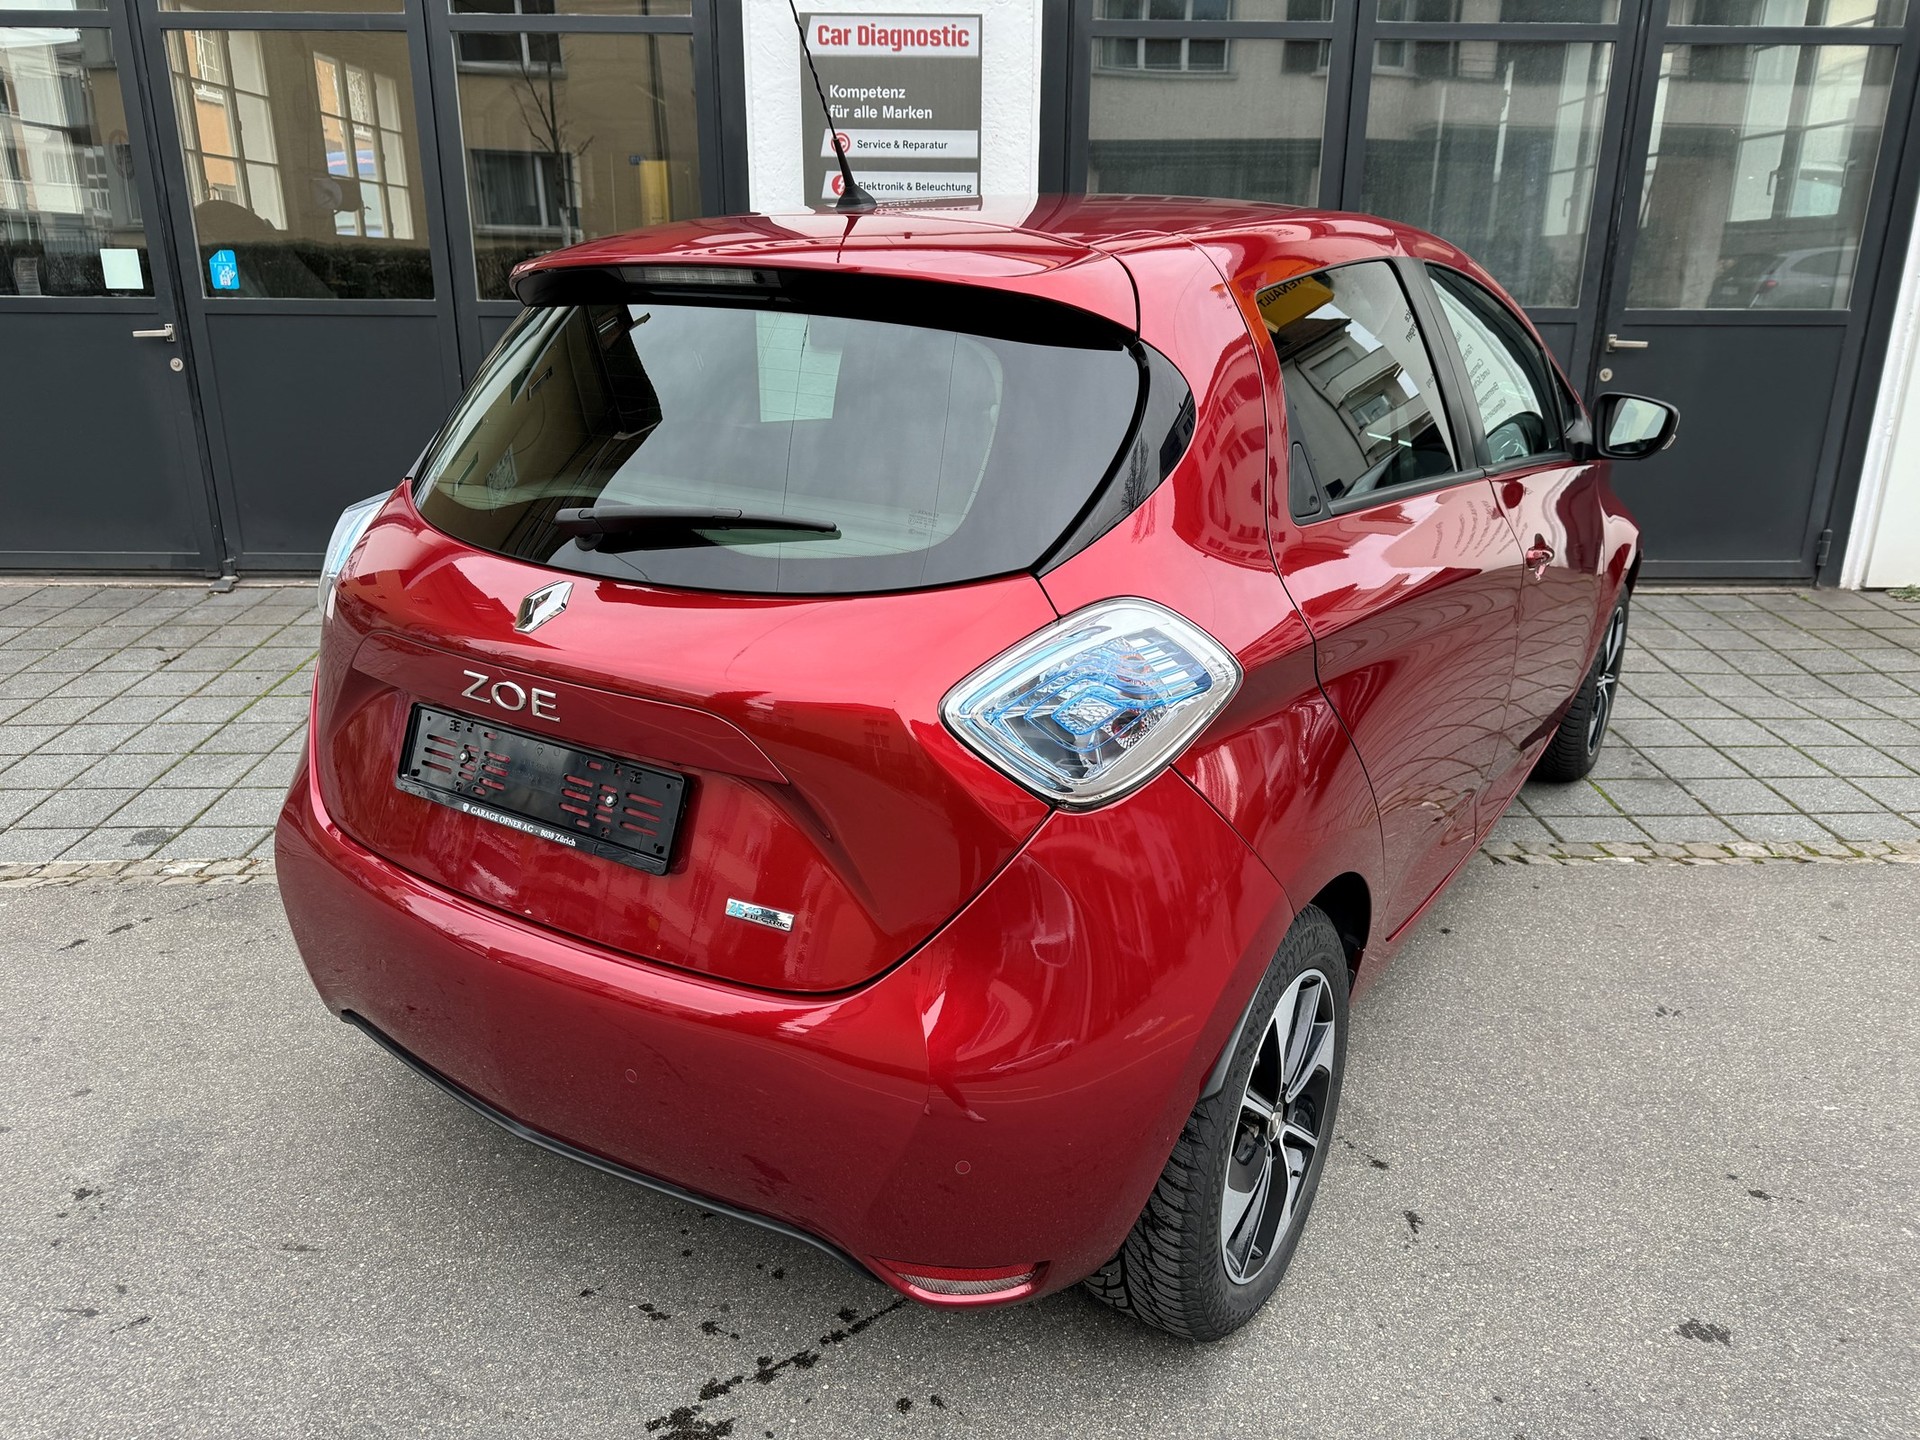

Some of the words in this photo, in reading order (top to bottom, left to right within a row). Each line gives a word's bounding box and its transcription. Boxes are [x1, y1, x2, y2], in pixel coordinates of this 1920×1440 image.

[818, 25, 851, 46] Car
[857, 23, 970, 51] Diagnostic
[829, 84, 906, 101] Kompetenz
[829, 105, 849, 119] für
[853, 105, 878, 119] alle
[882, 105, 933, 119] Marken
[857, 139, 891, 149] Service
[894, 140, 900, 149] &
[902, 140, 948, 151] Reparatur
[857, 181, 904, 191] Elektronik
[906, 182, 913, 191] &
[915, 182, 972, 193] Beleuchtung
[461, 669, 561, 722] ZOE
[470, 806, 499, 823] GARAGE
[499, 815, 522, 829] OFNER
[522, 824, 534, 833] AG
[555, 833, 576, 847] Zürich
[744, 913, 790, 929] ELECTRIC
